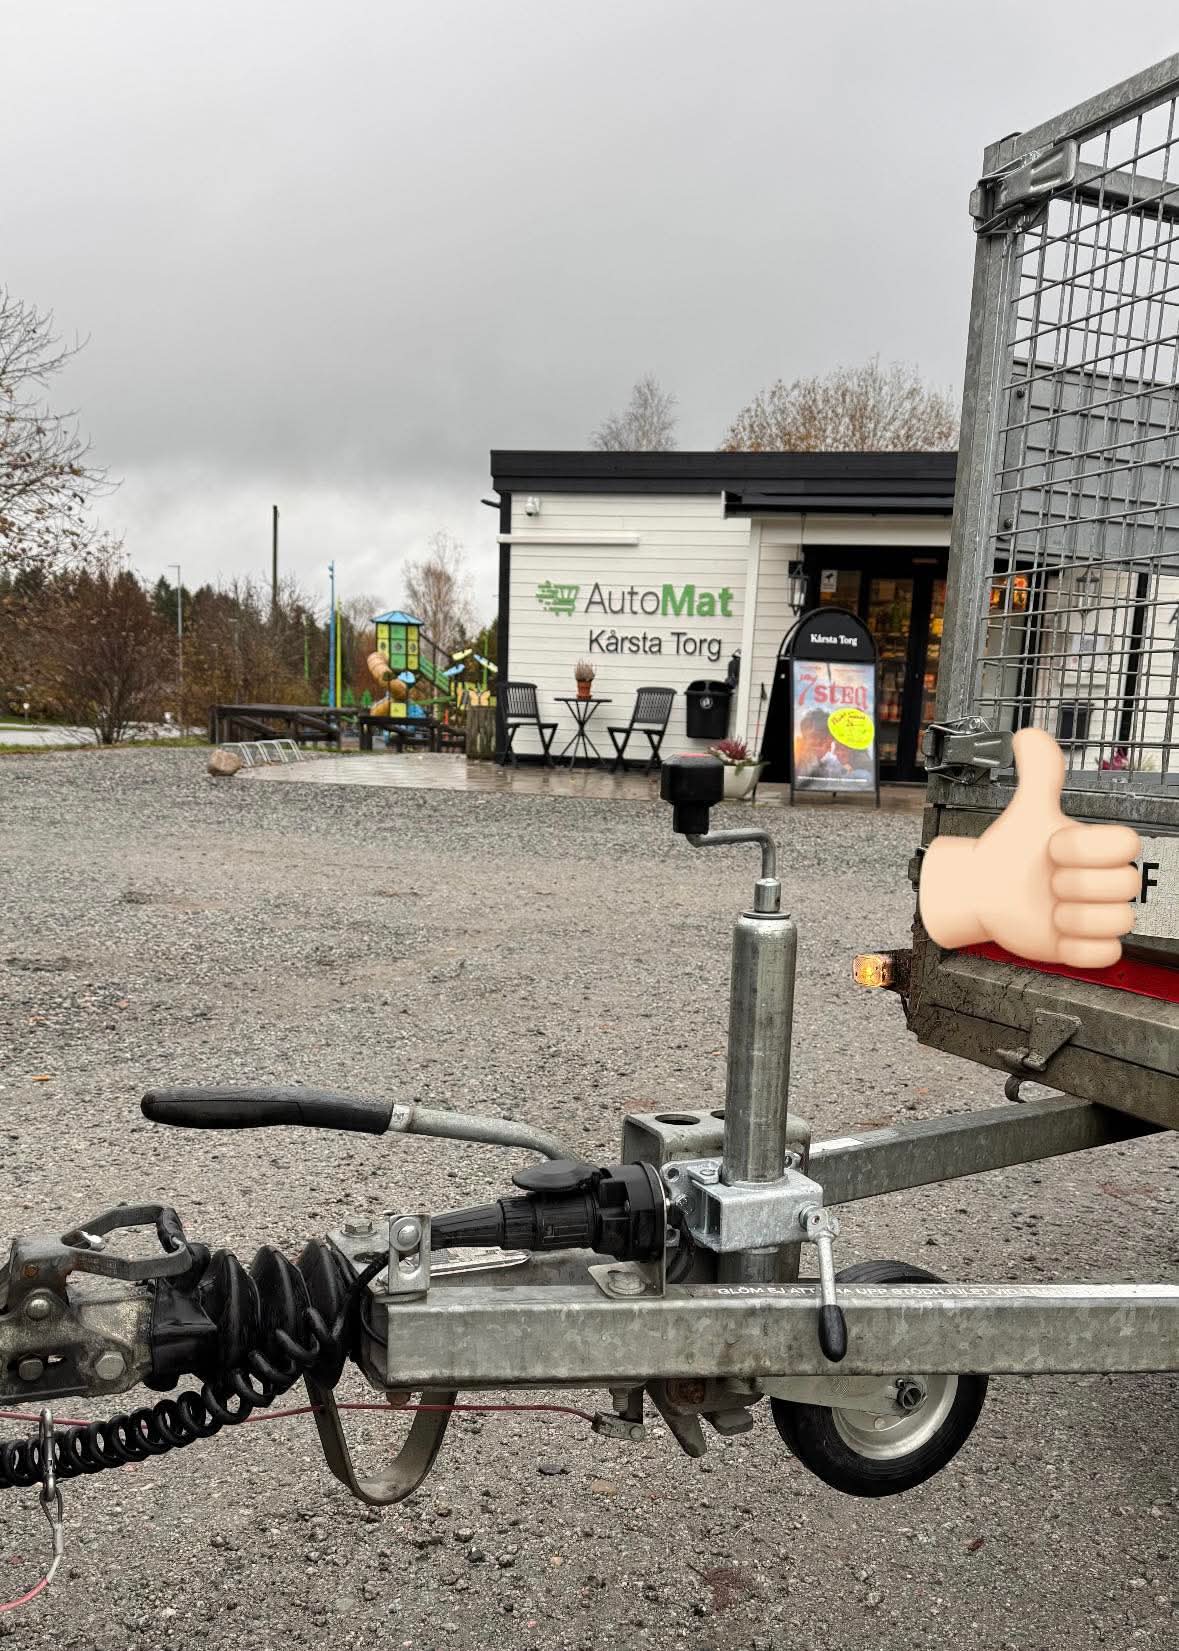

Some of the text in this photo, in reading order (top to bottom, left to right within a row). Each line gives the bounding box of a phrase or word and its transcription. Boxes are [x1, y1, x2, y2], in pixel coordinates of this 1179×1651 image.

[584, 582, 734, 617] AutoMat
[589, 629, 722, 662] Kårsta Torg
[810, 633, 858, 647] Kårsta Torg
